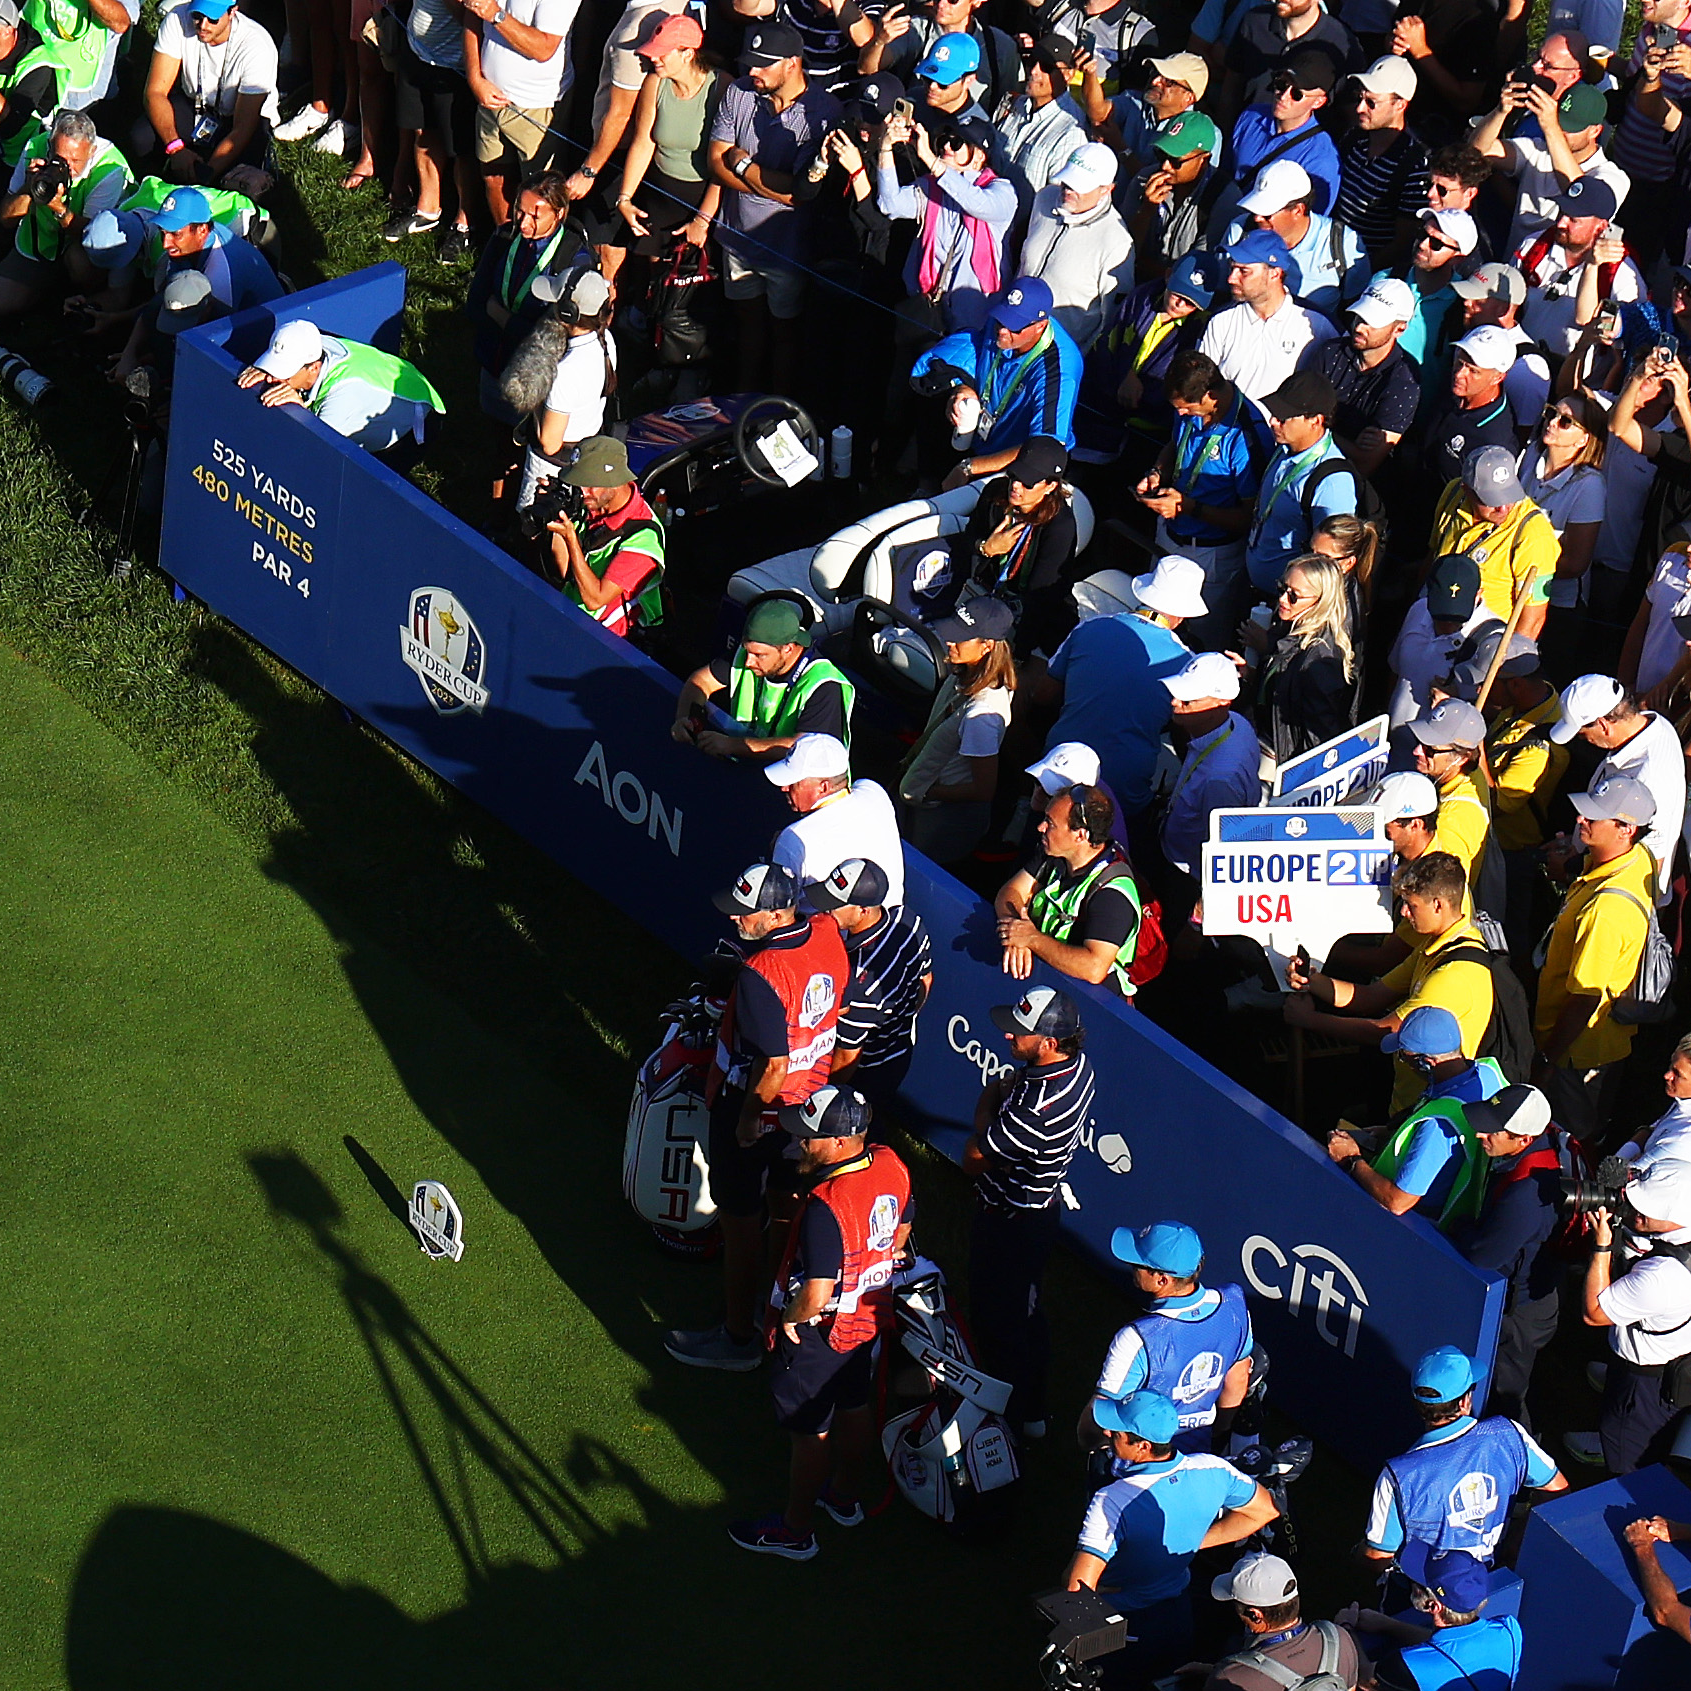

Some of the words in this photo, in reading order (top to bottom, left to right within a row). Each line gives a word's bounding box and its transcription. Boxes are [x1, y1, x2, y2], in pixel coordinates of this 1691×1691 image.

[213, 438, 247, 480] 525
[250, 469, 318, 530] YARDS
[192, 463, 229, 504] 480
[234, 492, 315, 564] METRES
[253, 541, 291, 588] PAR
[295, 577, 311, 599] 4
[404, 640, 454, 690] RYDER
[452, 673, 481, 706] CUP
[573, 740, 682, 857] AON
[1212, 853, 1321, 883] EUROPE
[1329, 852, 1357, 883] 2
[1360, 853, 1391, 883] UP
[1237, 894, 1293, 924] USA
[789, 1034, 835, 1068] HARMAN
[660, 1097, 700, 1223] USA
[862, 1266, 893, 1287] HOM
[1240, 1234, 1369, 1360] citi
[920, 1348, 983, 1395] USA
[976, 1435, 1002, 1450] USA
[1282, 1512, 1299, 1557] ROPE
